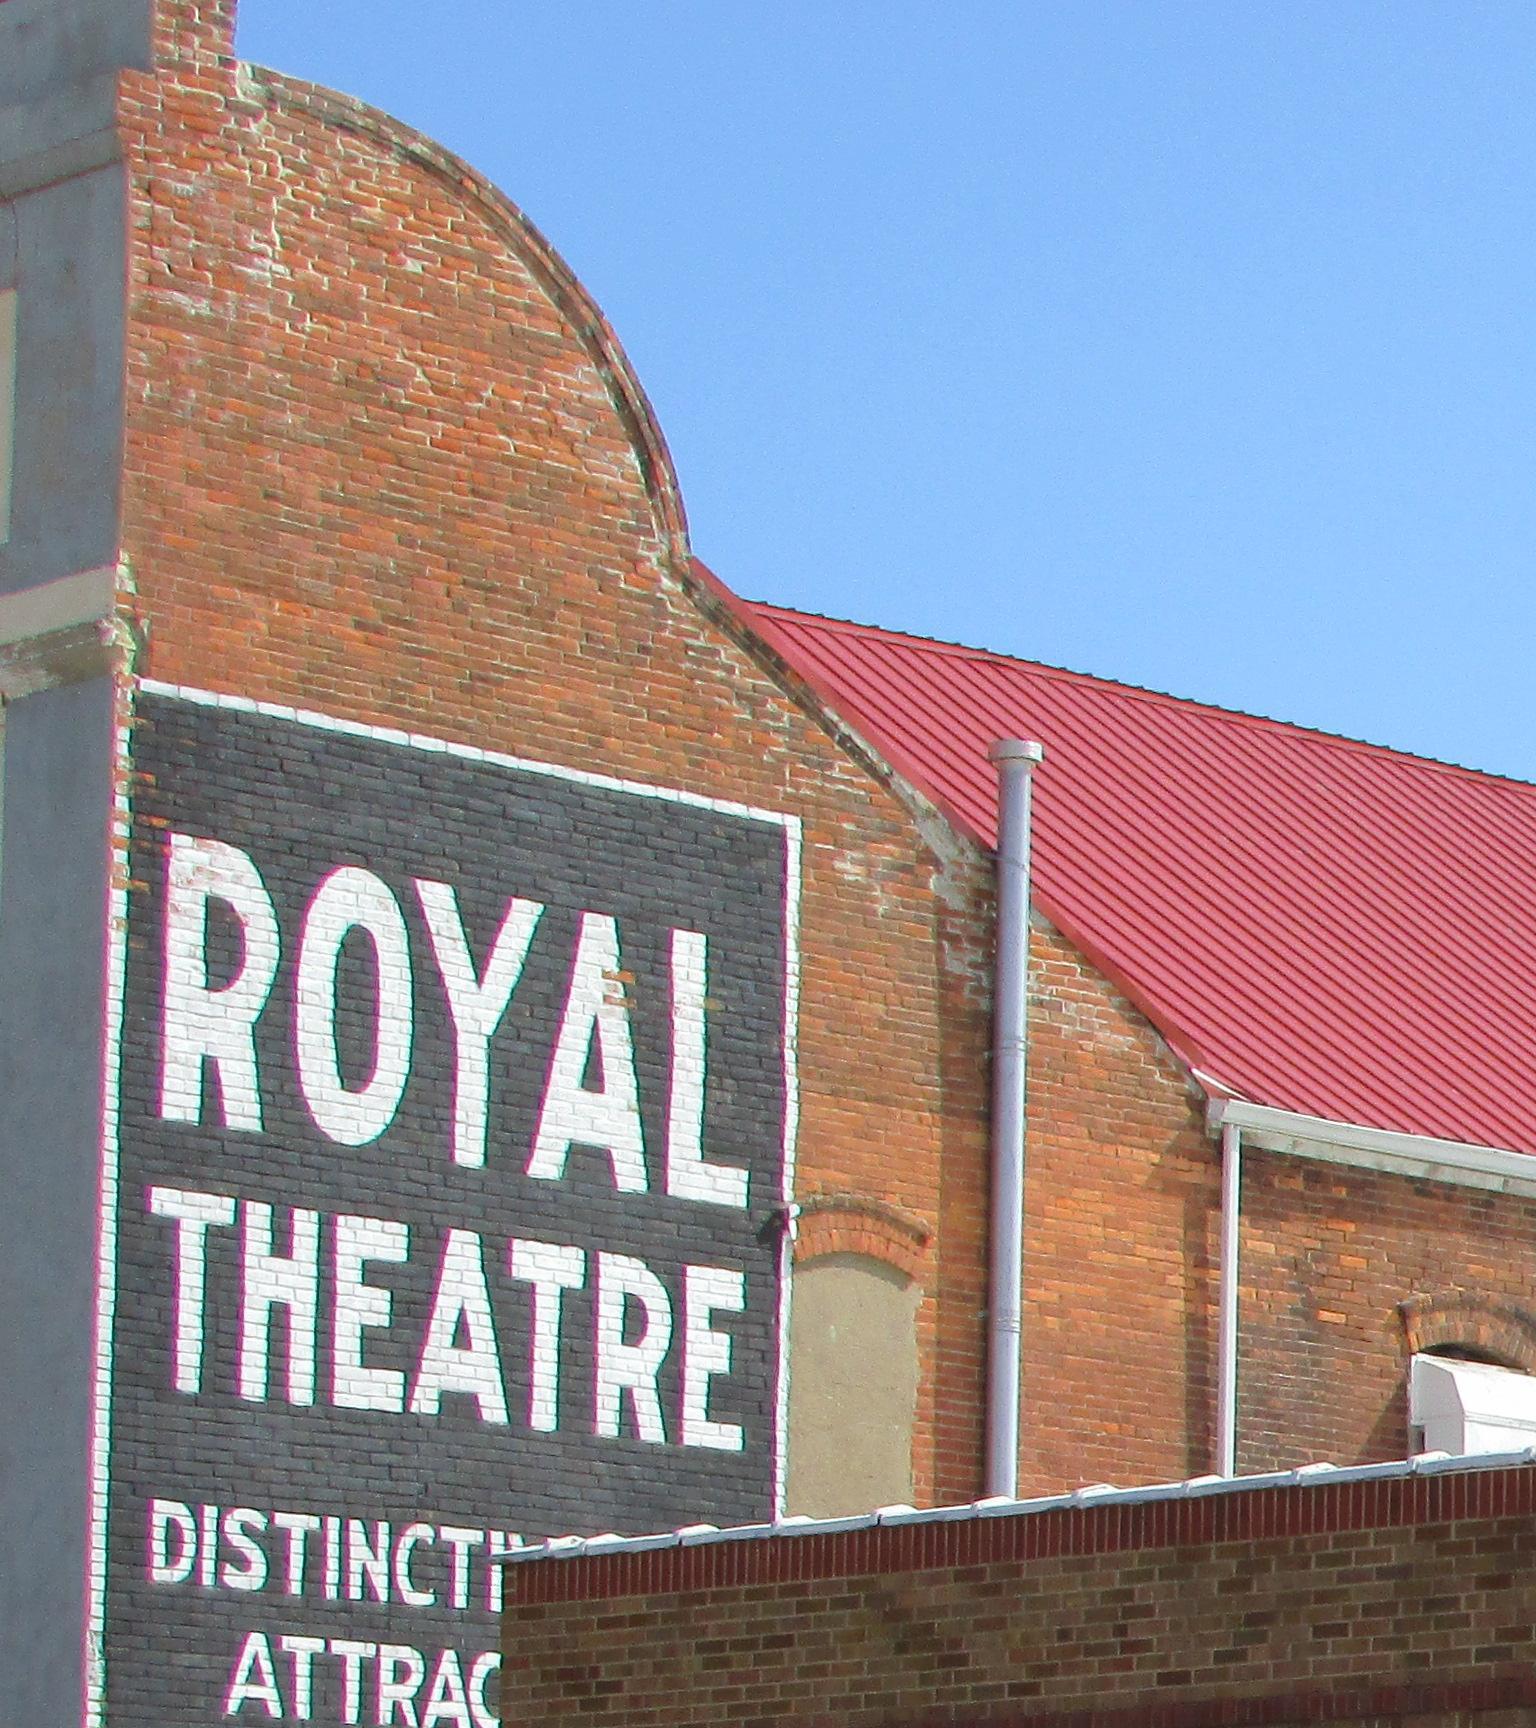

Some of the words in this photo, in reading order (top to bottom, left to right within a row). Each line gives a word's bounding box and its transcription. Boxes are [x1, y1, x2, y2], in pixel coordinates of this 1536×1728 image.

[160, 832, 750, 1208] ROYAL
[148, 1186, 745, 1451] THEATRE
[148, 1500, 525, 1612] DISTINCTI
